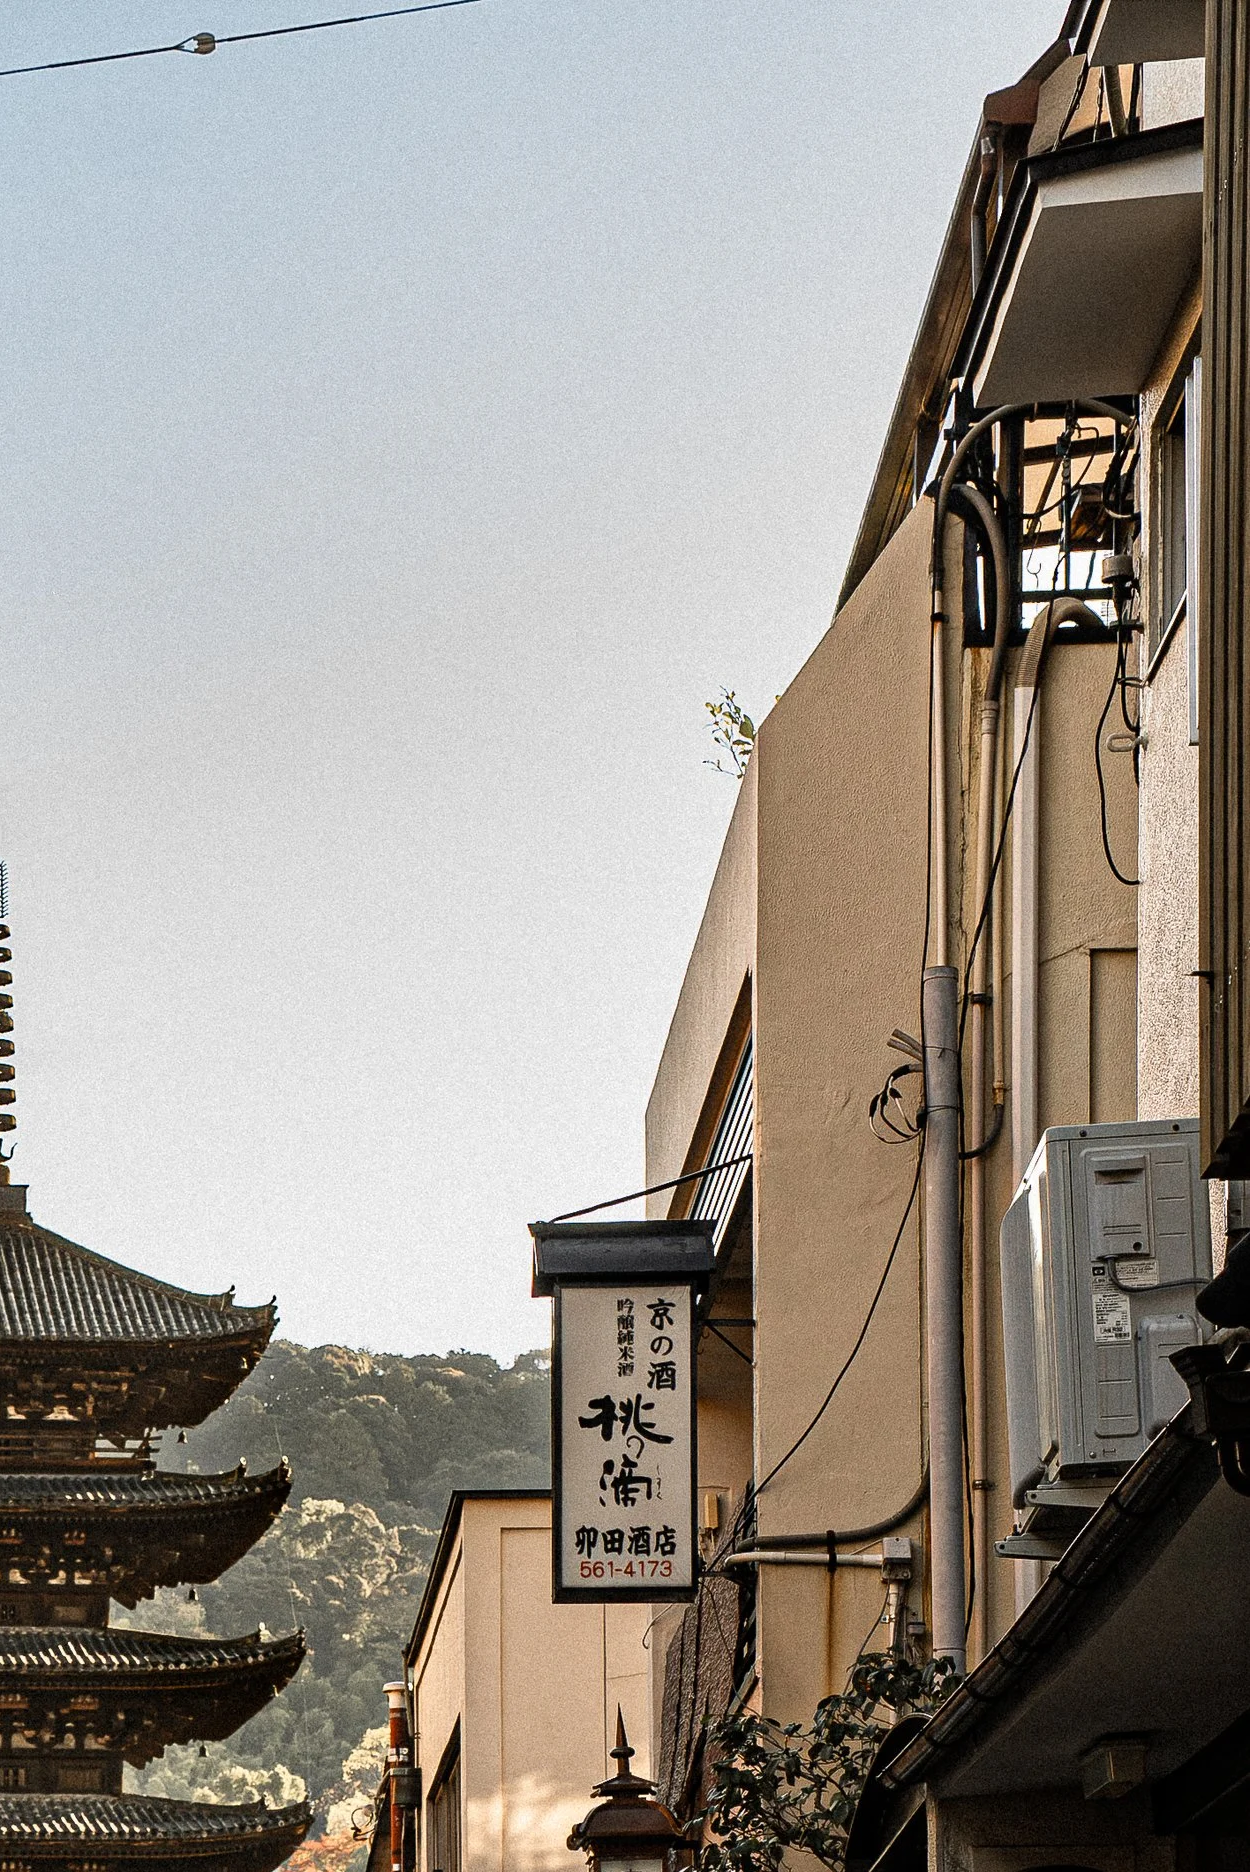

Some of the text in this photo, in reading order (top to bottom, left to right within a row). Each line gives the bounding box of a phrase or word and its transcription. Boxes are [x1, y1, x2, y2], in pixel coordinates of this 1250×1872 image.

[646, 1298, 676, 1391] 京の酒
[575, 1525, 677, 1559] 卯田酒店
[580, 1560, 673, 1578] 561-4173
